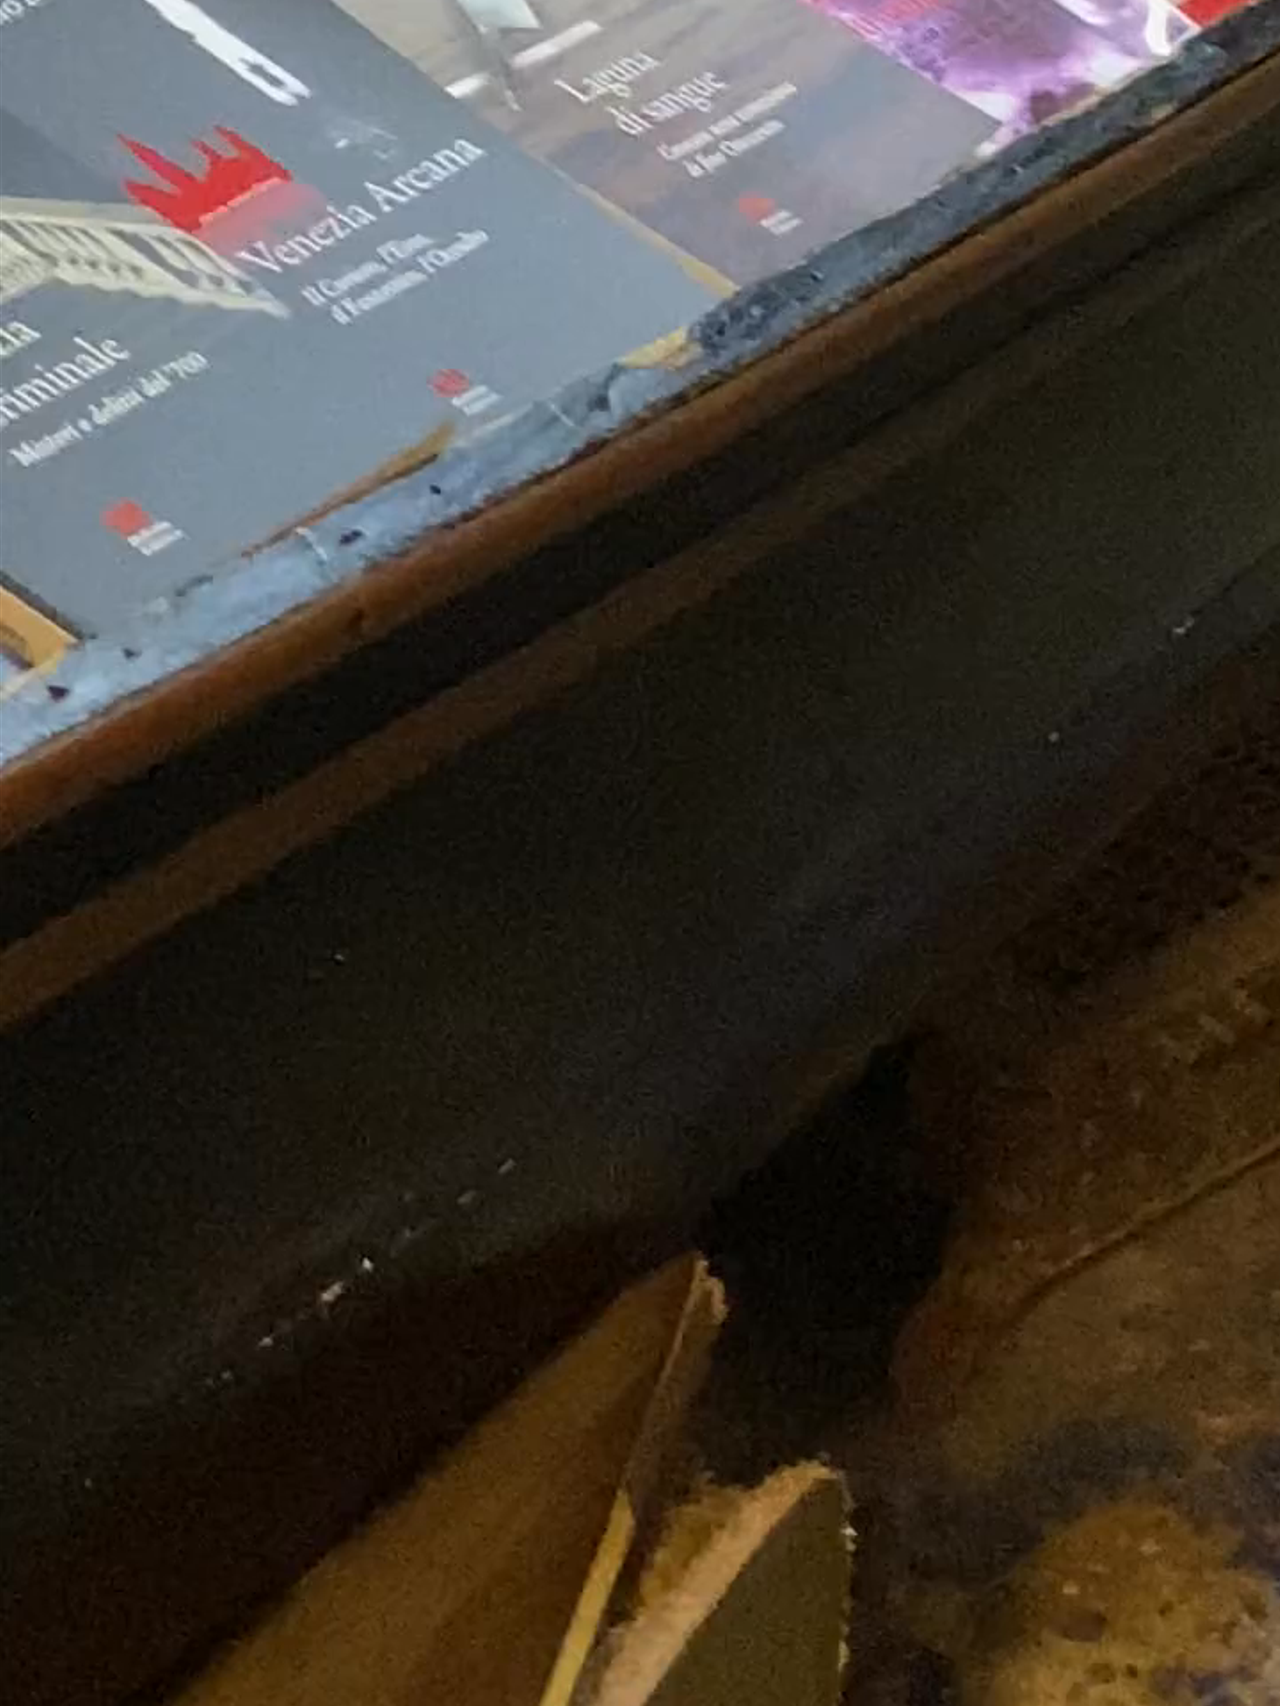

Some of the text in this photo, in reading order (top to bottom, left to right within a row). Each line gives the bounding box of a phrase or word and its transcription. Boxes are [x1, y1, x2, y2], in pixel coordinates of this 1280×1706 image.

[554, 49, 662, 104] Laguna
[641, 70, 727, 122] sangue
[235, 139, 487, 273] Venezia Arcana
[0, 336, 131, 427] riminale
